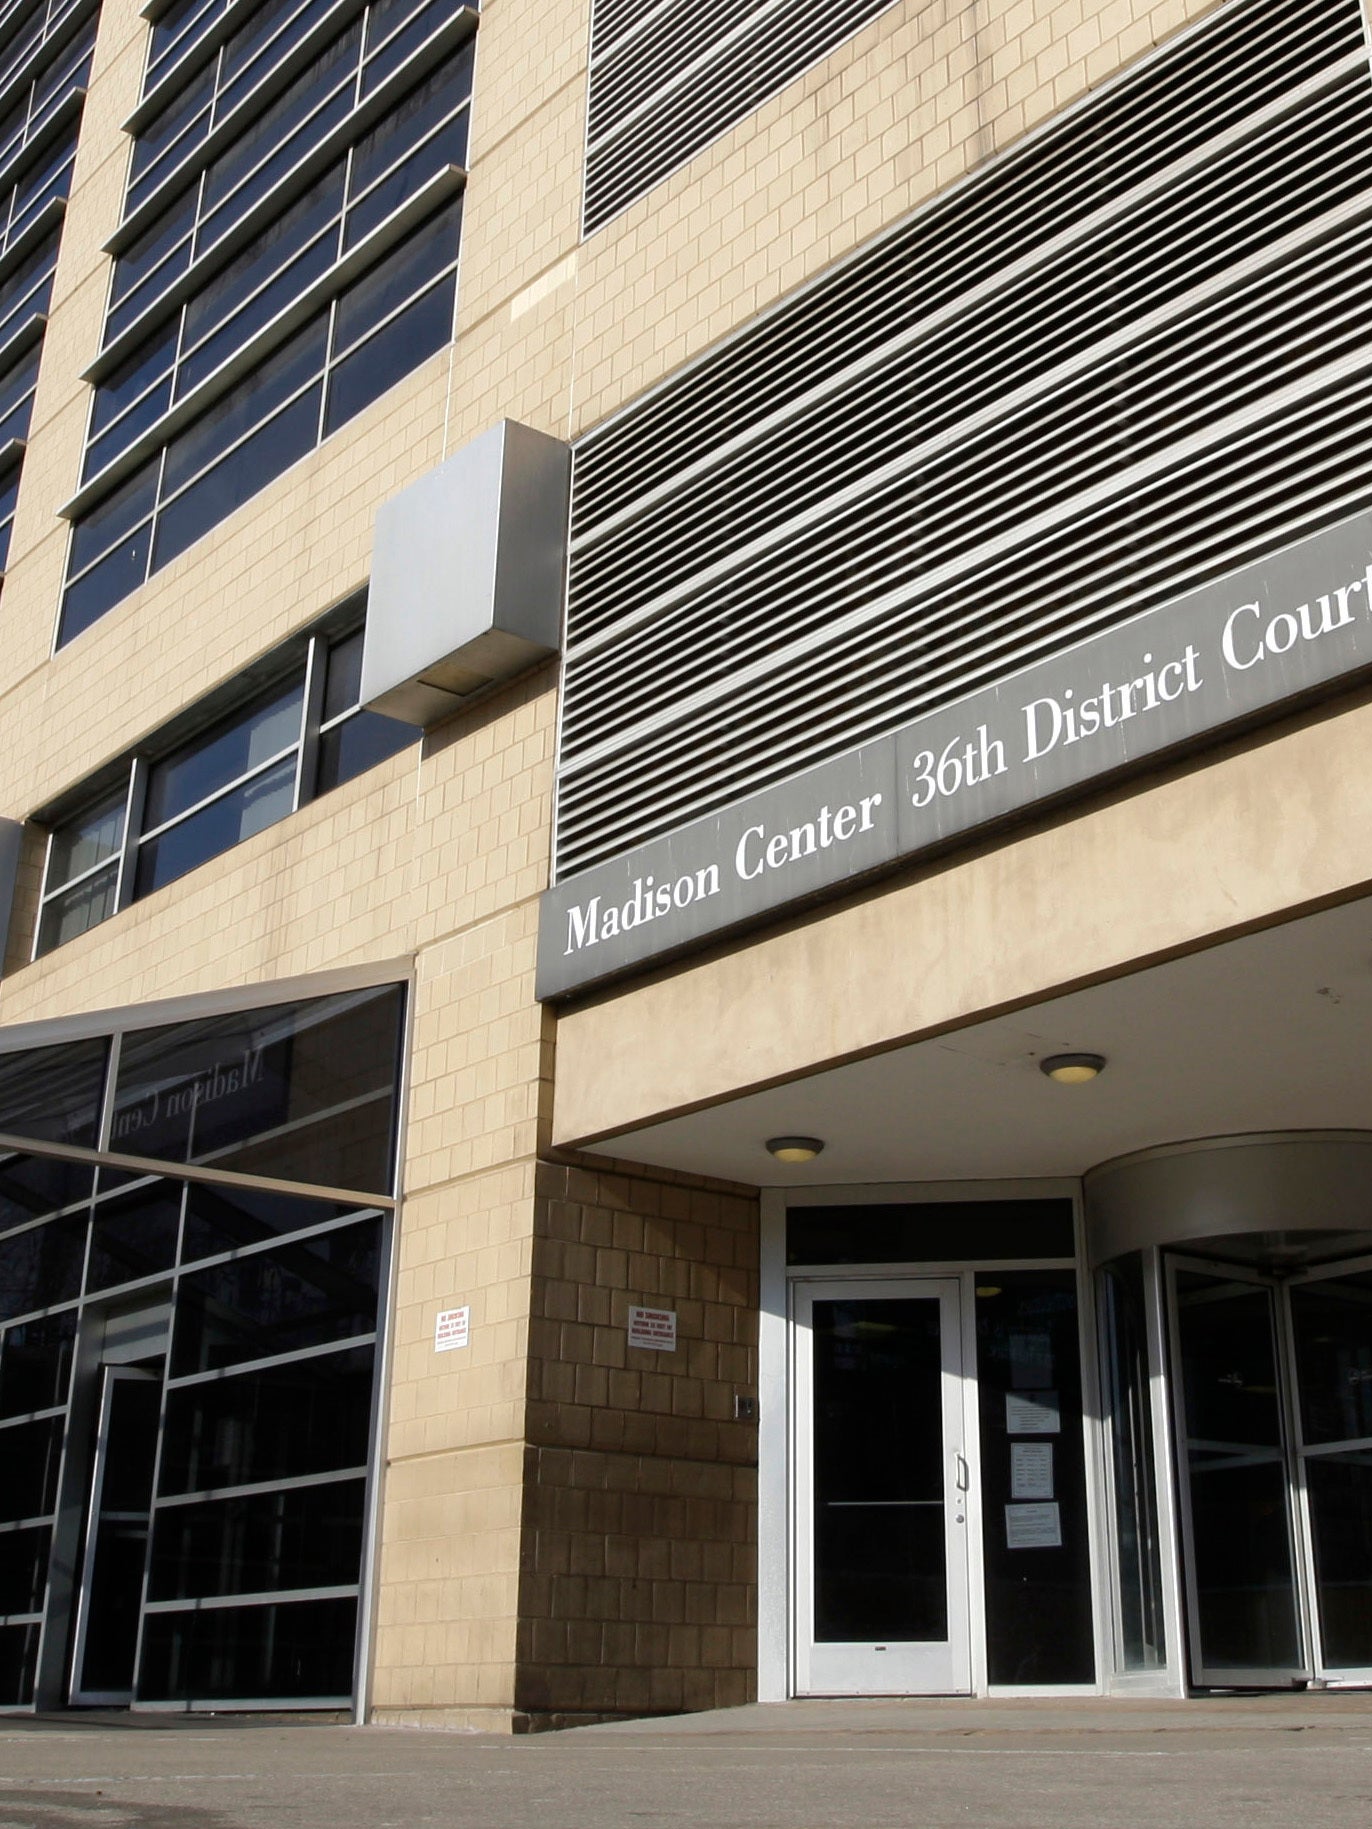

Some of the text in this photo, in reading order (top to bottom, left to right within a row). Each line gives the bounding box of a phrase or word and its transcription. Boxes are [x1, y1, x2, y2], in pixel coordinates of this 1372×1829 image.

[563, 875, 721, 956] Madison
[734, 792, 882, 881] Center
[911, 724, 1009, 808] 36th
[1021, 643, 1205, 763] District
